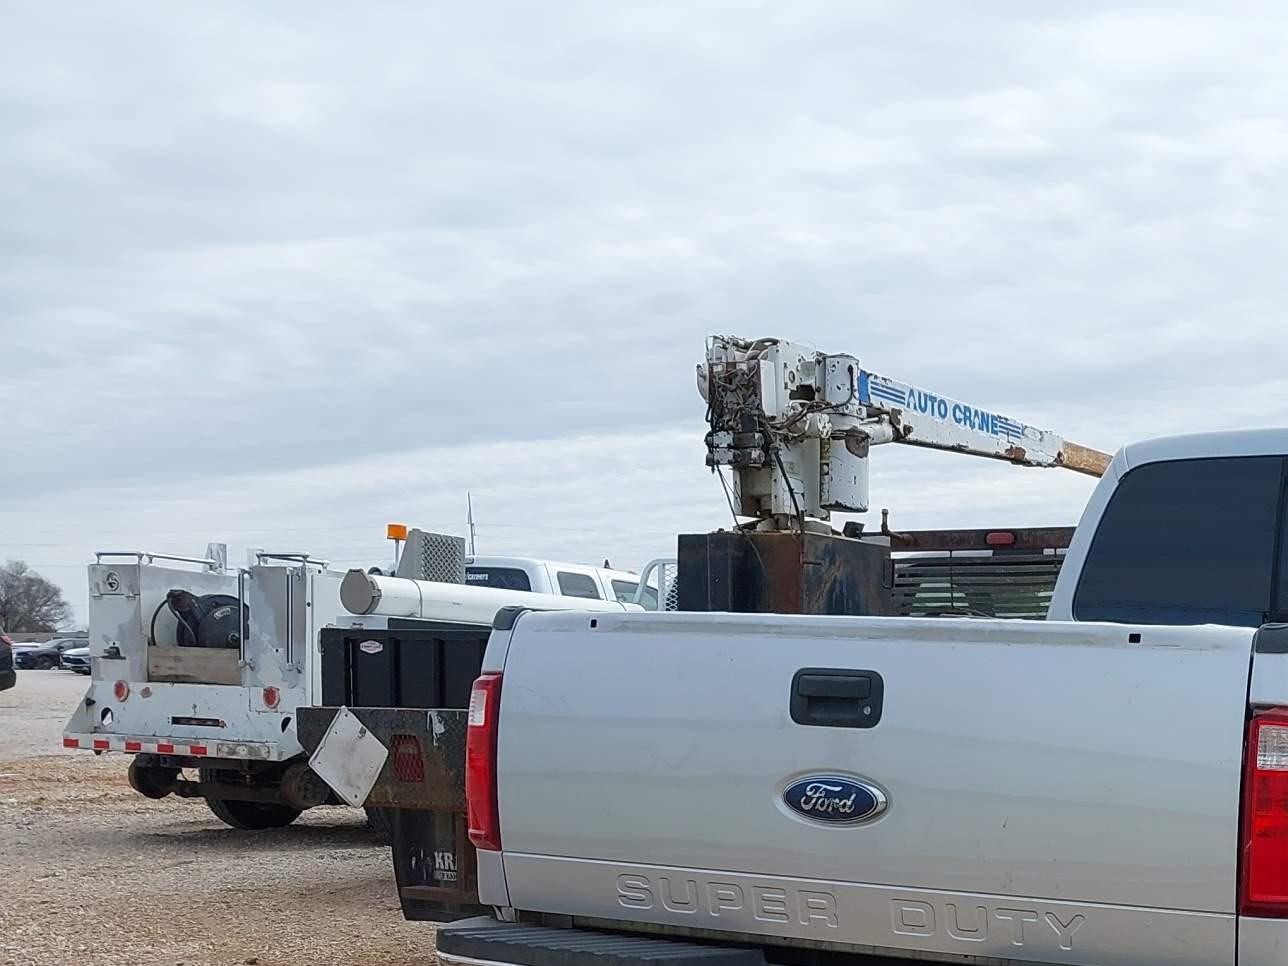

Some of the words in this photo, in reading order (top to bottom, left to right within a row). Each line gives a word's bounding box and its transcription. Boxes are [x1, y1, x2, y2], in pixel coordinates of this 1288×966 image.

[906, 387, 948, 419] AUTO
[951, 402, 999, 436] CRANE
[800, 782, 857, 814] Ford
[433, 850, 457, 871] KR
[615, 872, 840, 929] SUPER
[891, 897, 1087, 951] DUTY
